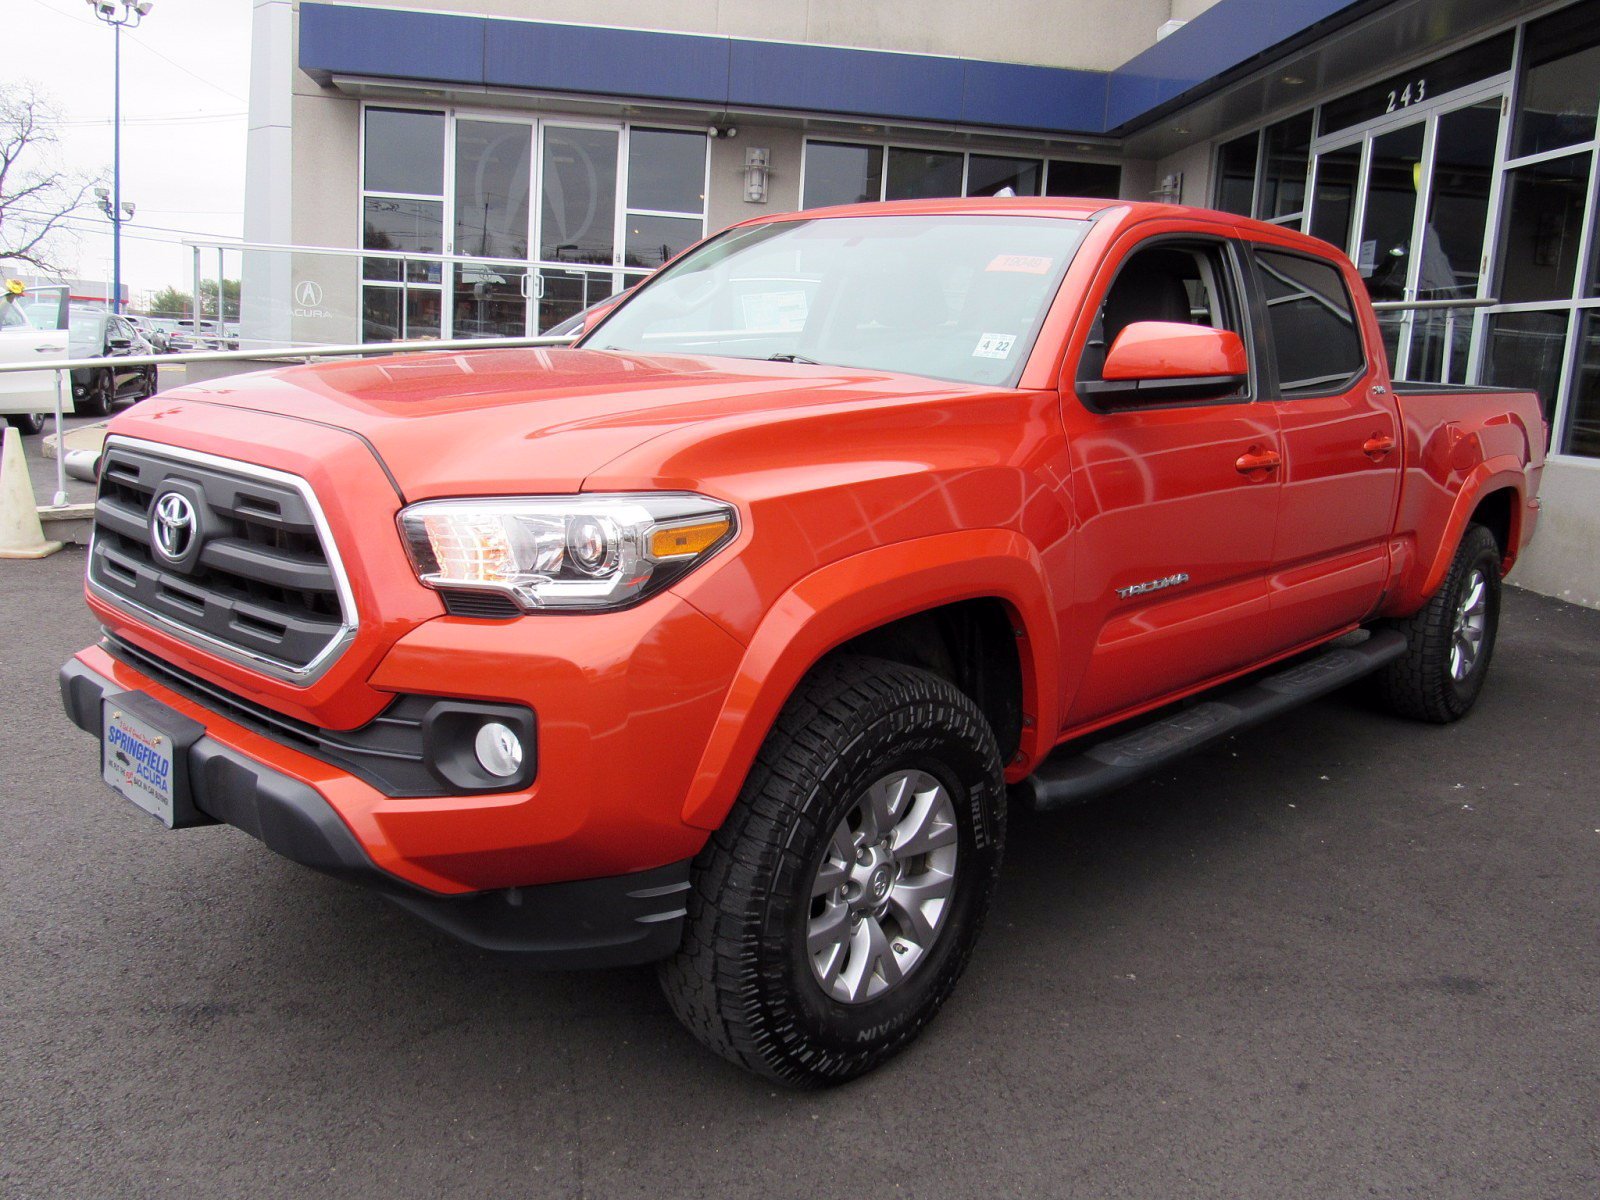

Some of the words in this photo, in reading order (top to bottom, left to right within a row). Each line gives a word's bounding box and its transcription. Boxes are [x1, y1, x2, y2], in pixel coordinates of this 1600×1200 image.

[1385, 79, 1426, 114] 243
[982, 340, 991, 351] 4
[995, 341, 1010, 352] 22
[1115, 572, 1189, 600] TACOMA
[108, 725, 169, 778] SPRINGFIELD
[136, 763, 168, 795] ACURA
[969, 780, 985, 850] PIRELLI
